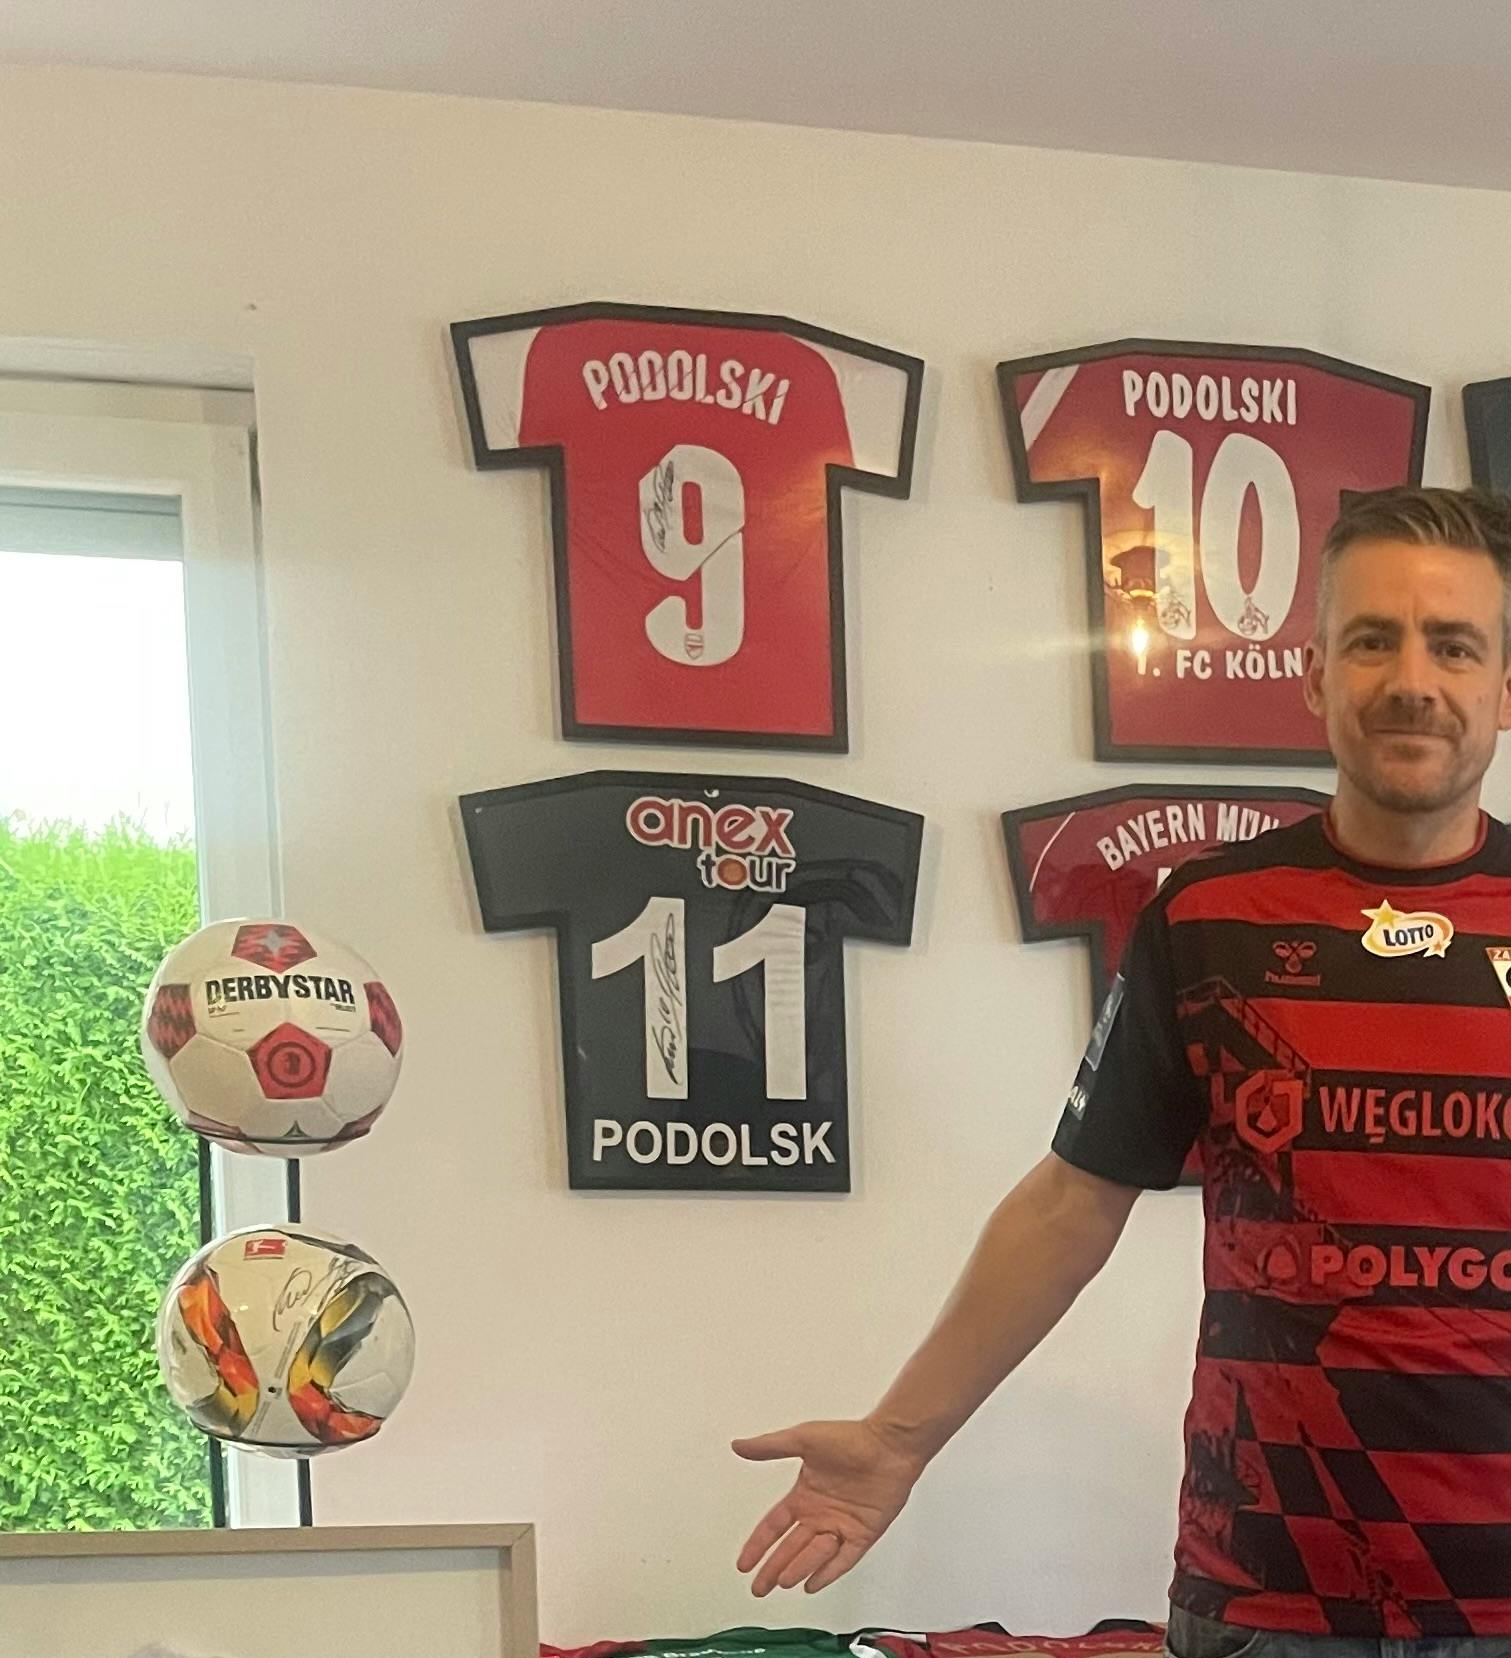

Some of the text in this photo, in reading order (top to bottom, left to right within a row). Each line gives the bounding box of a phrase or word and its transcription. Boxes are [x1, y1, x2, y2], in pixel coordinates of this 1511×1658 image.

[582, 350, 790, 425] PODOLSKI
[1122, 370, 1297, 425] PODOLSKI
[639, 444, 745, 667] 9
[1131, 430, 1301, 642] 10
[1175, 649, 1213, 681] FC
[1225, 644, 1304, 681] KÖLN
[626, 795, 795, 859] anex
[1096, 803, 1206, 871] BAYERN
[696, 850, 796, 893] tour
[1382, 924, 1435, 948] LOTTO
[205, 974, 356, 1005] DERBYSTAR
[591, 896, 807, 1100] 11
